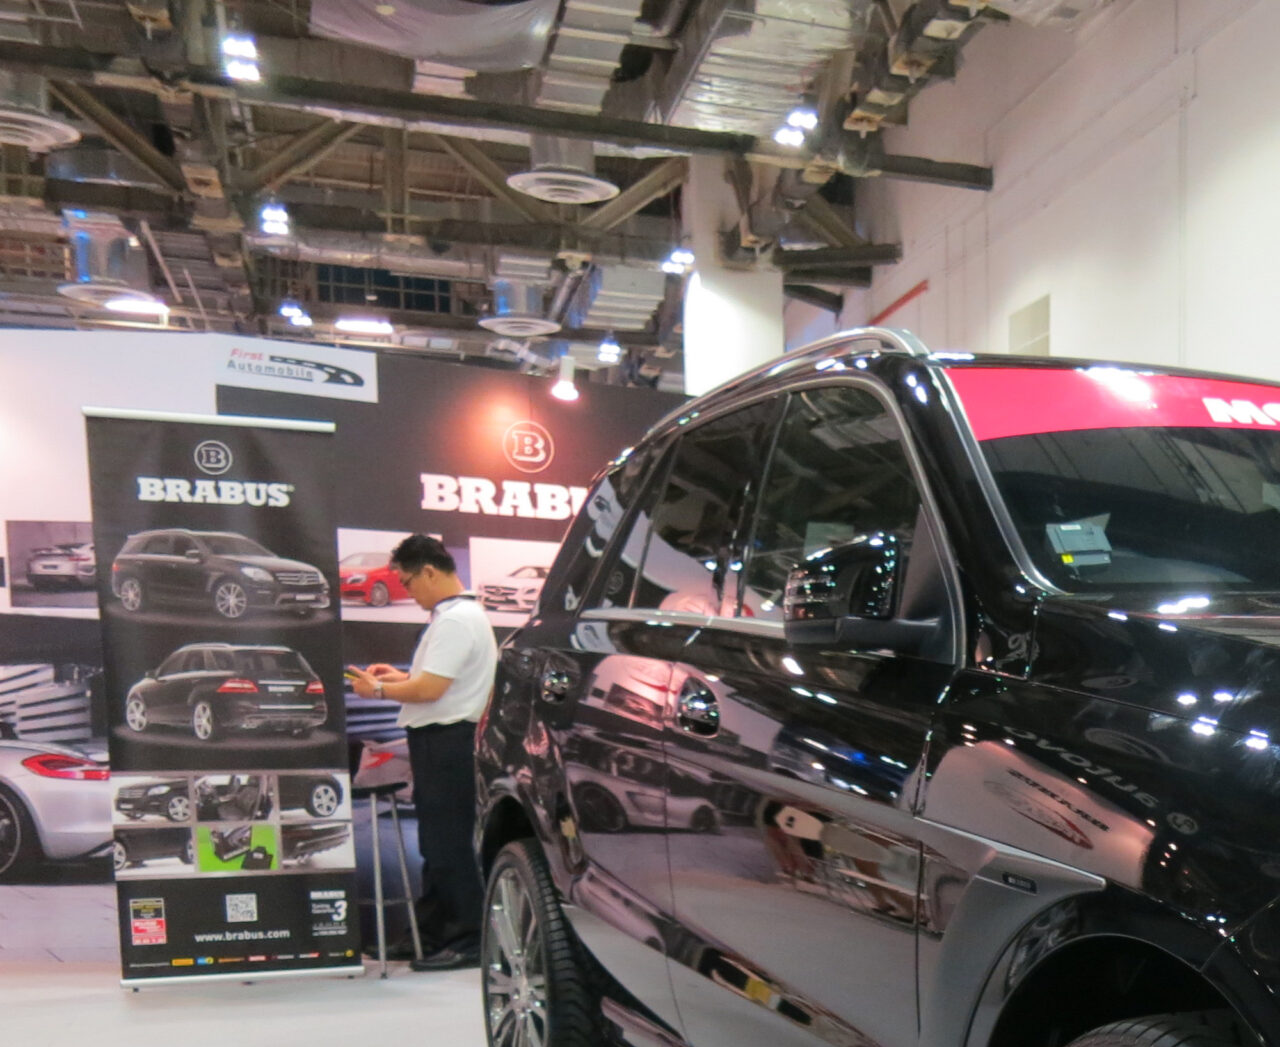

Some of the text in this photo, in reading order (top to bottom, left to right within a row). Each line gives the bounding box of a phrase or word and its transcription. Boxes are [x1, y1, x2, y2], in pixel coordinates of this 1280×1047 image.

[230, 348, 263, 361] First
[226, 359, 313, 378] Automobile
[137, 477, 291, 507] BRABUS
[332, 900, 348, 921] 3
[194, 930, 290, 942] www.brabus.com
